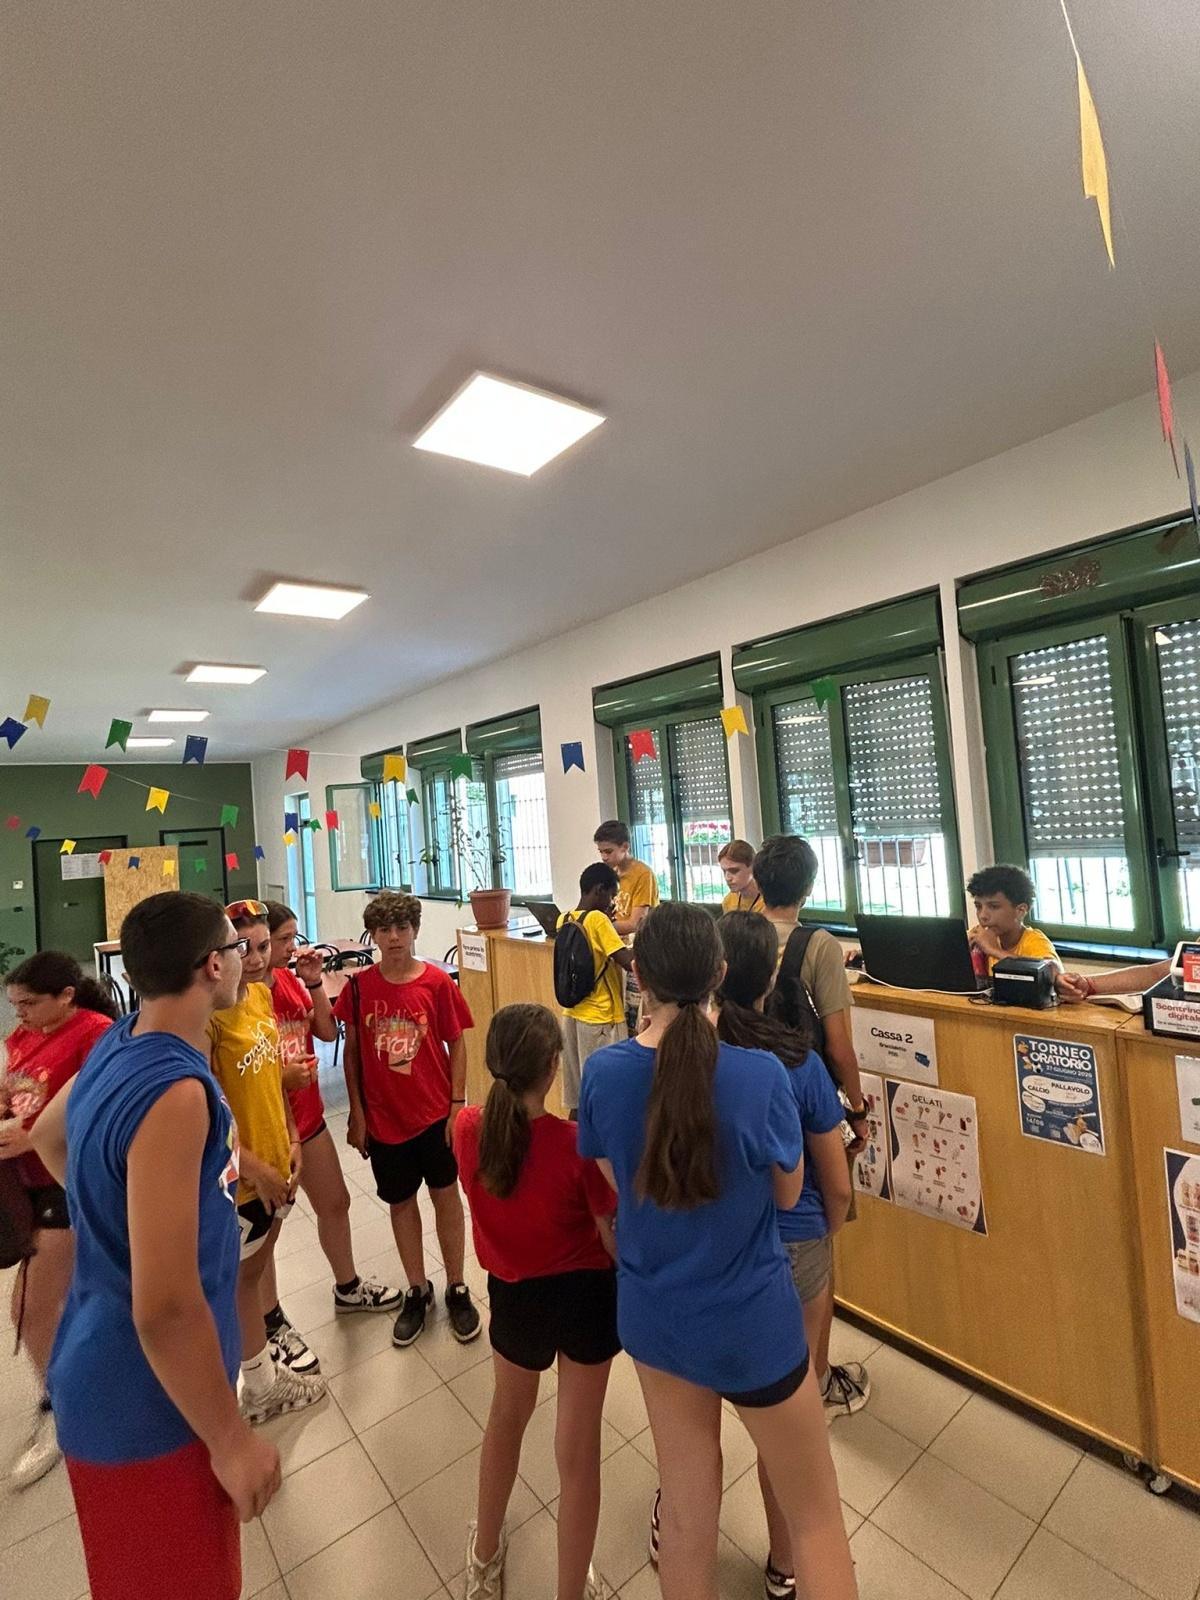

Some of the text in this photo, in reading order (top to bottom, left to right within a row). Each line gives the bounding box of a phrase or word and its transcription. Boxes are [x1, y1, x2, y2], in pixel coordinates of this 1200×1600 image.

[870, 1027, 914, 1044] Cassa 2
[375, 1029, 420, 1061] fra!
[1029, 1040, 1091, 1060] TORNEO
[1030, 1051, 1092, 1071] ORATORIO
[1027, 1084, 1050, 1094] CALCIO
[1051, 1082, 1090, 1095] PALLAVOLO
